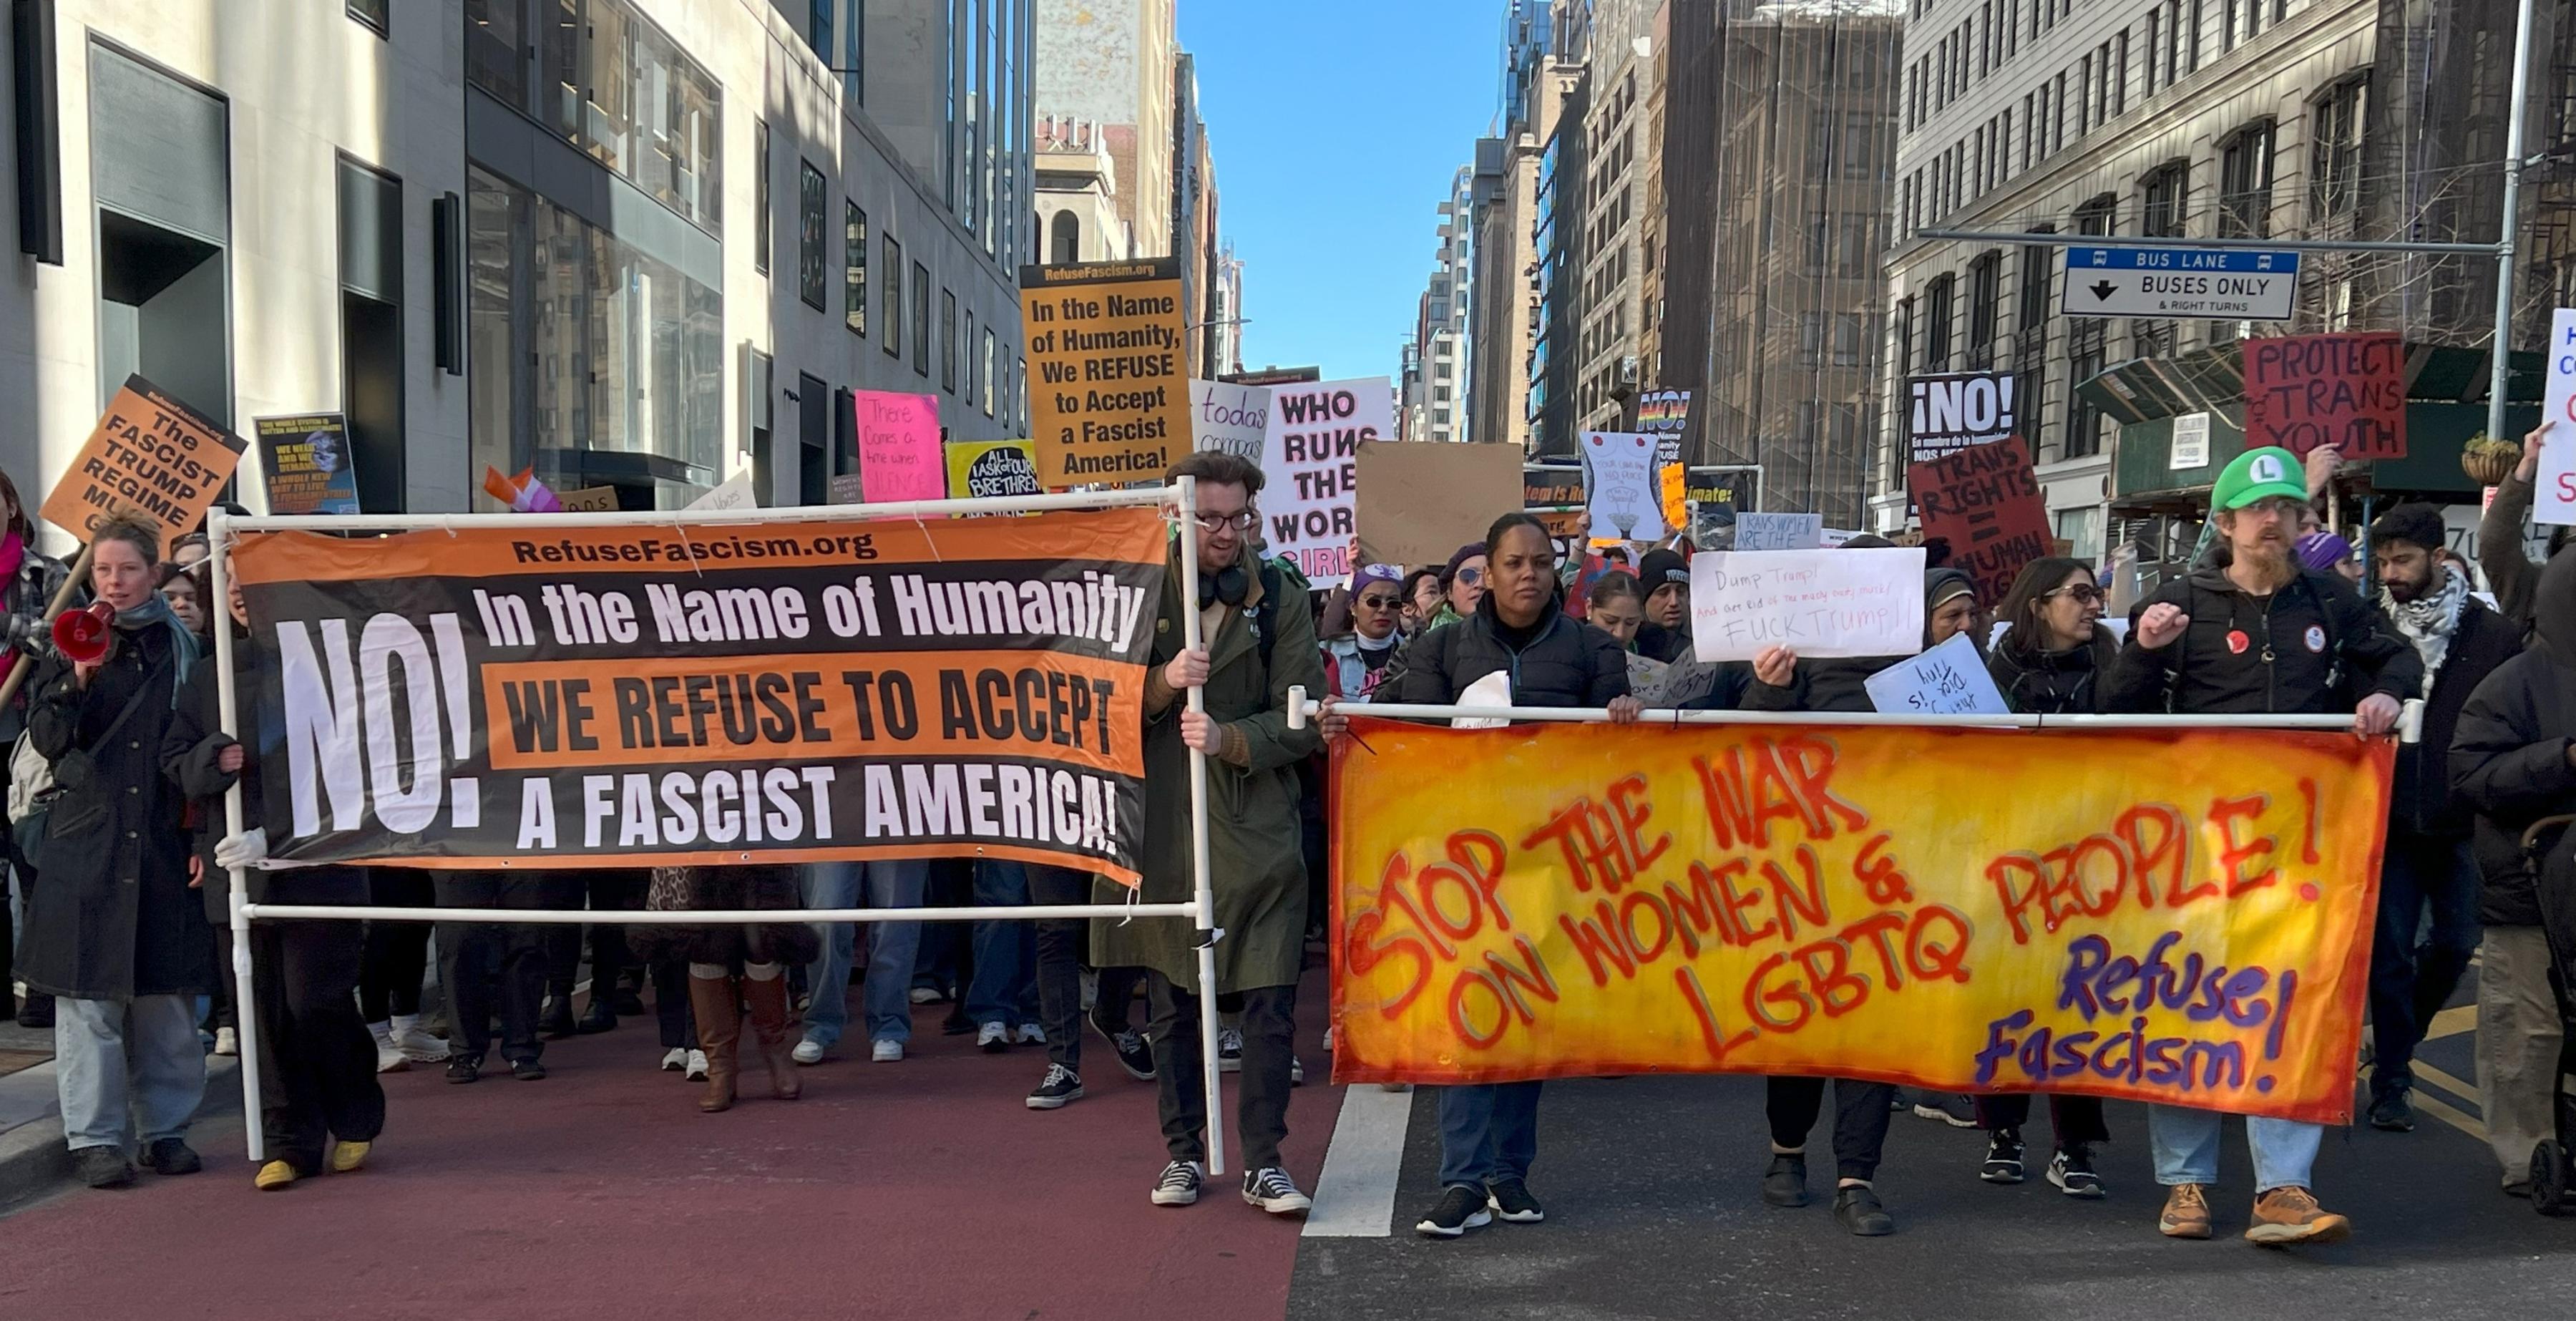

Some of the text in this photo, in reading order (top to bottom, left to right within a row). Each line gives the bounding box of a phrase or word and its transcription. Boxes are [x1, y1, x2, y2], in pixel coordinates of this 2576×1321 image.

[1044, 263, 1155, 281] RefuseFascism.org
[2137, 253, 2228, 269] BUS LANE
[2142, 276, 2270, 296] BUSES ONLY
[1031, 294, 1174, 322] In the Name
[2159, 301, 2248, 312] & RIGHT TURNS
[1032, 323, 1181, 354] of Humanity,
[1041, 354, 1175, 384] We REFUSE
[2257, 338, 2402, 384] PROTECT
[1055, 386, 1166, 414] to Accept
[1202, 387, 1267, 429] todas
[1280, 390, 1356, 424] WHO
[1636, 390, 1691, 432] NO!
[1912, 376, 2014, 434] ¡NO!
[2268, 379, 2402, 420] TRANS
[152, 411, 198, 451] The
[864, 426, 898, 445] Comes
[1061, 416, 1166, 444] a Fascist
[1658, 432, 1681, 441] Name
[1951, 436, 1961, 446] de
[2265, 417, 2396, 455] YOUTH
[105, 414, 220, 488] FASCIST
[275, 444, 316, 454] WE NEED
[278, 454, 297, 463] AND
[867, 449, 887, 464] time
[988, 449, 1013, 464] ALL
[1063, 447, 1168, 475] America!
[1200, 434, 1262, 459] compas
[1913, 449, 1938, 462] NOS
[104, 439, 196, 500] TRUMP
[278, 474, 310, 483] WHOLE
[311, 472, 332, 481] NEW
[978, 462, 1002, 477] ASK
[1011, 459, 1035, 476] OUR
[1924, 441, 2019, 484] TRANS
[2258, 459, 2275, 479] L
[83, 456, 189, 528] REGIME
[271, 484, 293, 493] WAY
[294, 483, 306, 492] TO
[867, 469, 928, 494] SILENCE
[970, 474, 1041, 497] BRETHREN
[1294, 464, 1355, 501] THE
[1922, 465, 2038, 523] RIGHTS
[1777, 514, 1815, 536] WOMEN
[511, 532, 879, 565] RefuseFascism.org
[1737, 532, 1797, 549] ARE THE
[1953, 530, 2045, 579] HUMAN
[1714, 570, 1762, 591] Dump
[1767, 563, 1819, 585] Trump!
[472, 570, 1146, 653] In the Name of Humanity
[1723, 598, 1913, 648] FUCK Trump!!
[1915, 658, 1952, 685] Tiny
[275, 612, 480, 839] NO!
[502, 667, 1114, 756] WE REFUSE TO ACCEPT
[516, 763, 1118, 856] A FASCIST AMERICA!
[1345, 733, 1872, 1021] STOP THE WAR
[1674, 777, 2326, 1061] LGBTQ PEOPLE!
[1448, 829, 1916, 1051] ON WOMEN &
[2057, 930, 2272, 1028] Refuse
[1974, 968, 2298, 1094] Fascism!
